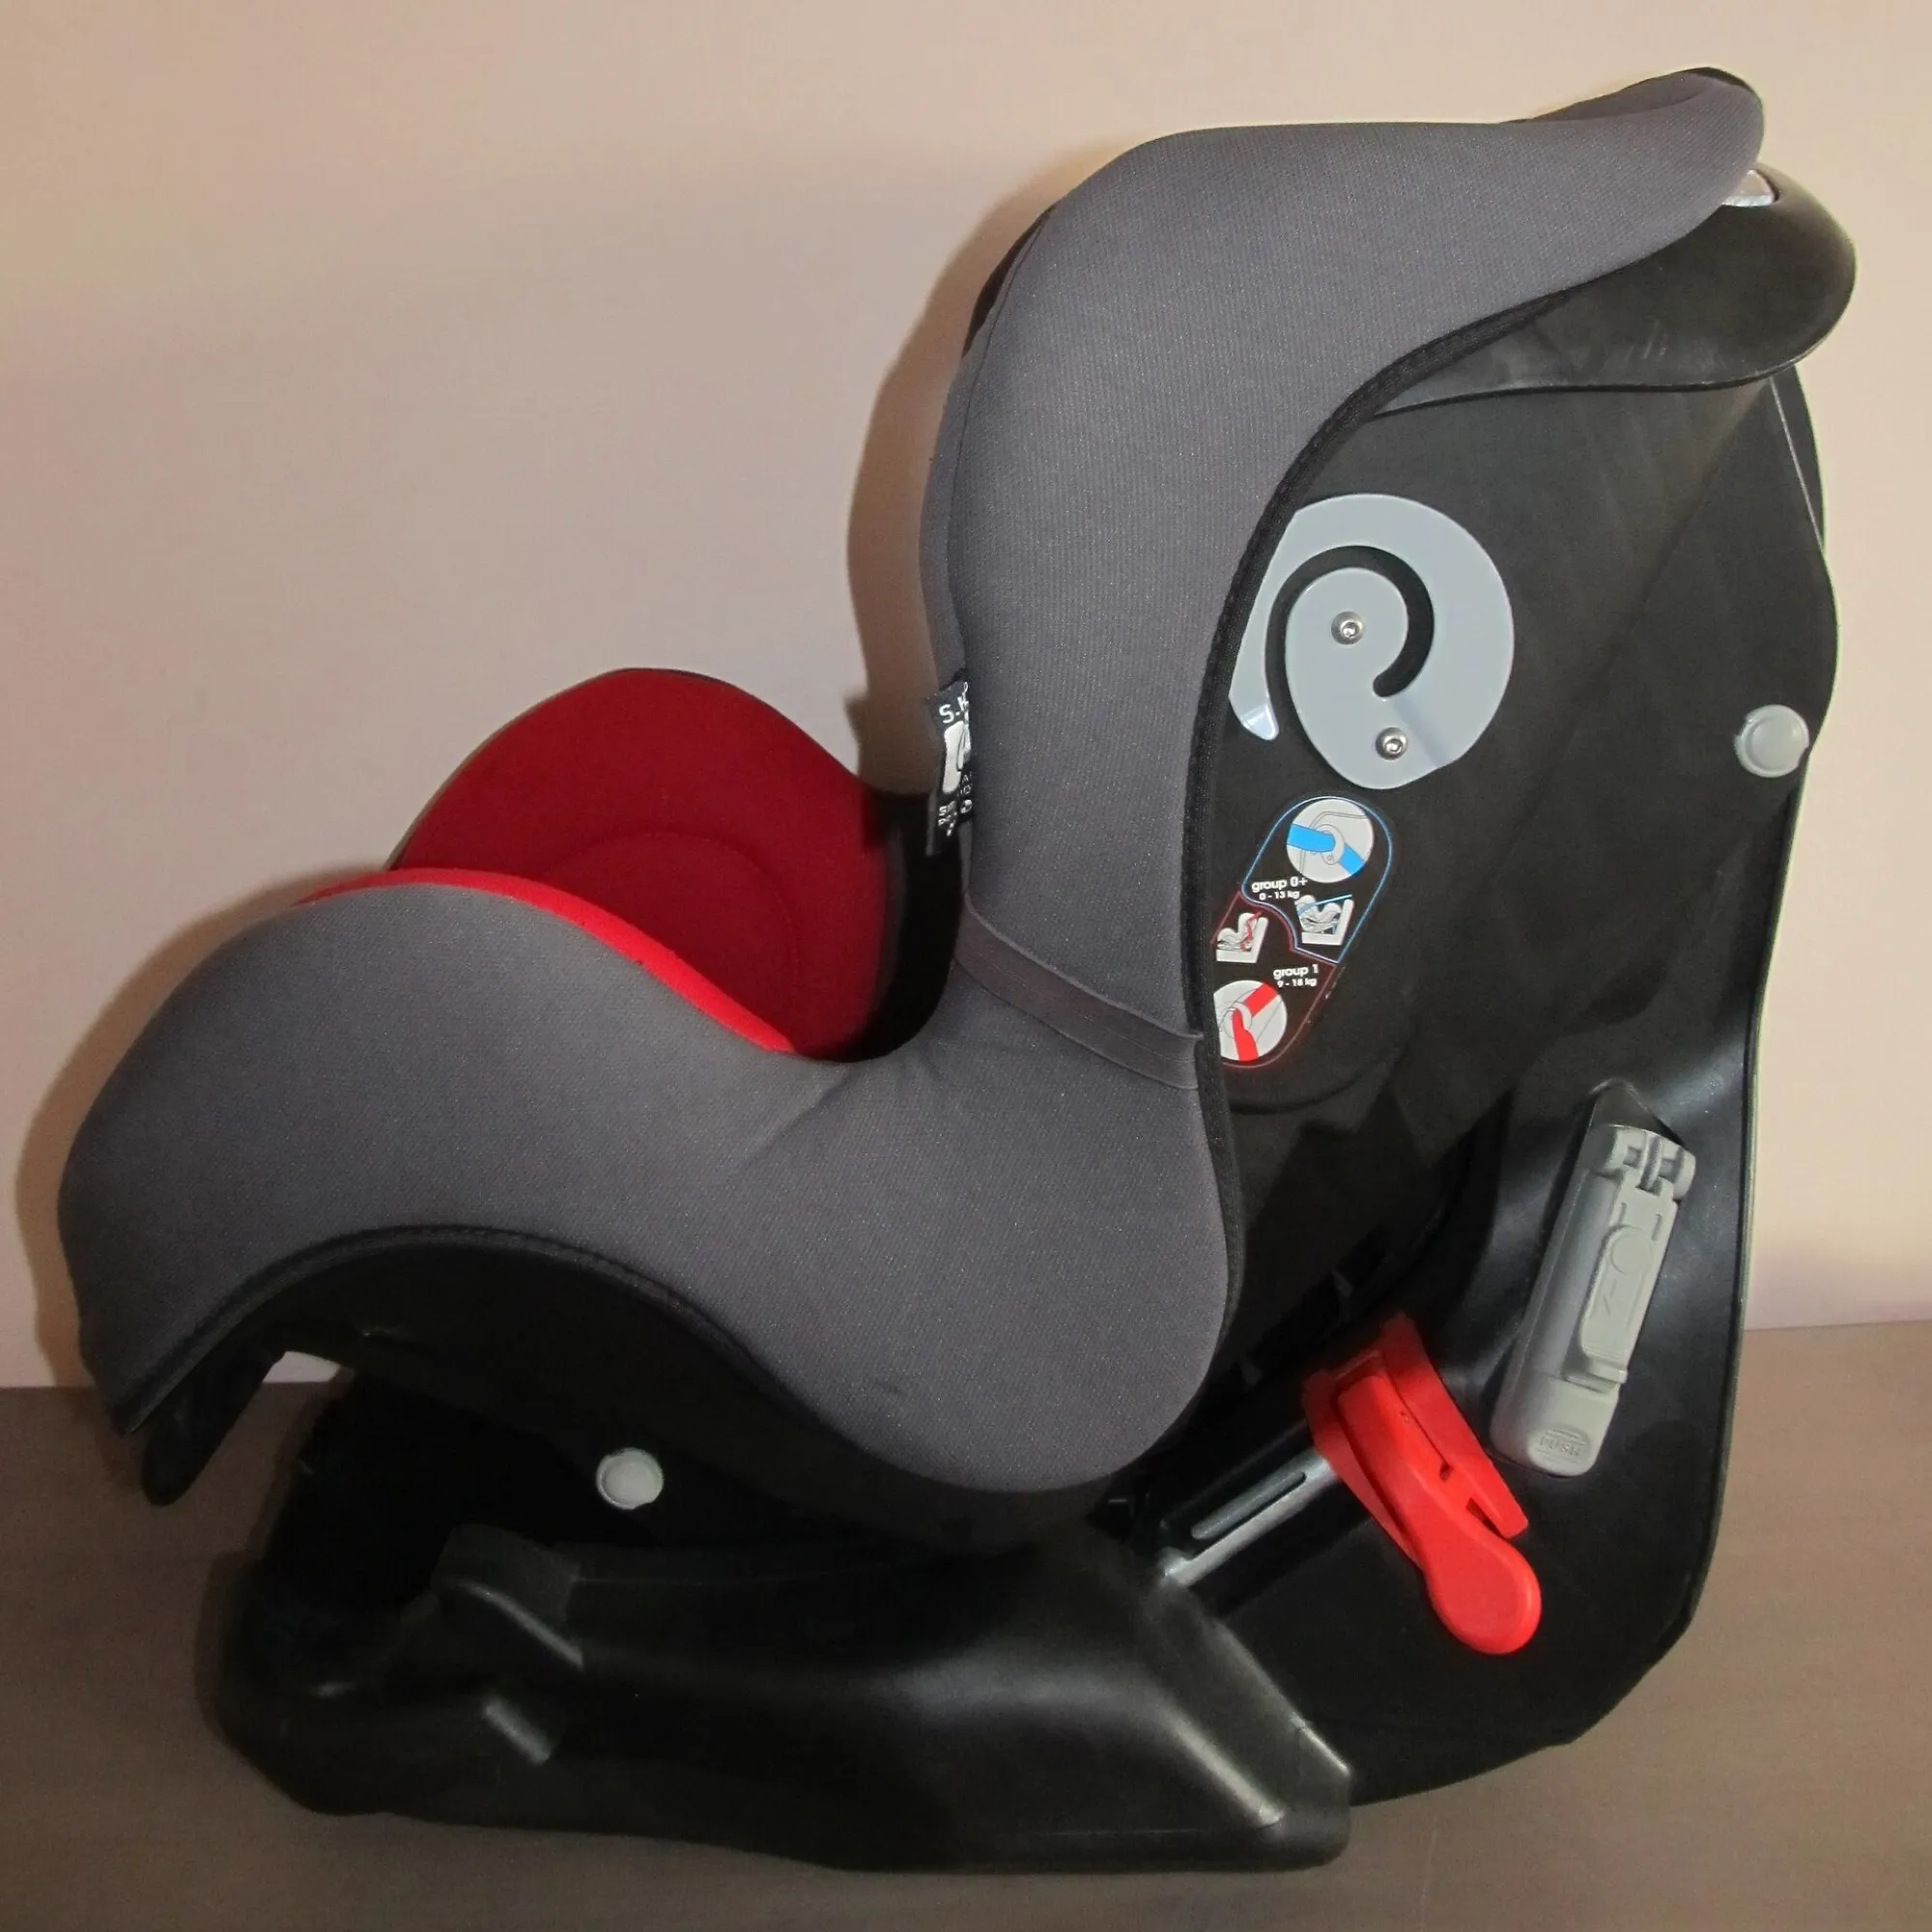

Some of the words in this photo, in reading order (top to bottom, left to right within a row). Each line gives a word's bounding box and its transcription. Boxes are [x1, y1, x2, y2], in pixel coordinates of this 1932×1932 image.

[1251, 880, 1287, 893] group
[1290, 876, 1308, 887] 0+
[1259, 892, 1266, 901] 0
[1274, 891, 1286, 899] 13
[1273, 967, 1308, 980] group
[1312, 964, 1319, 974] 1
[1304, 978, 1317, 986] kg
